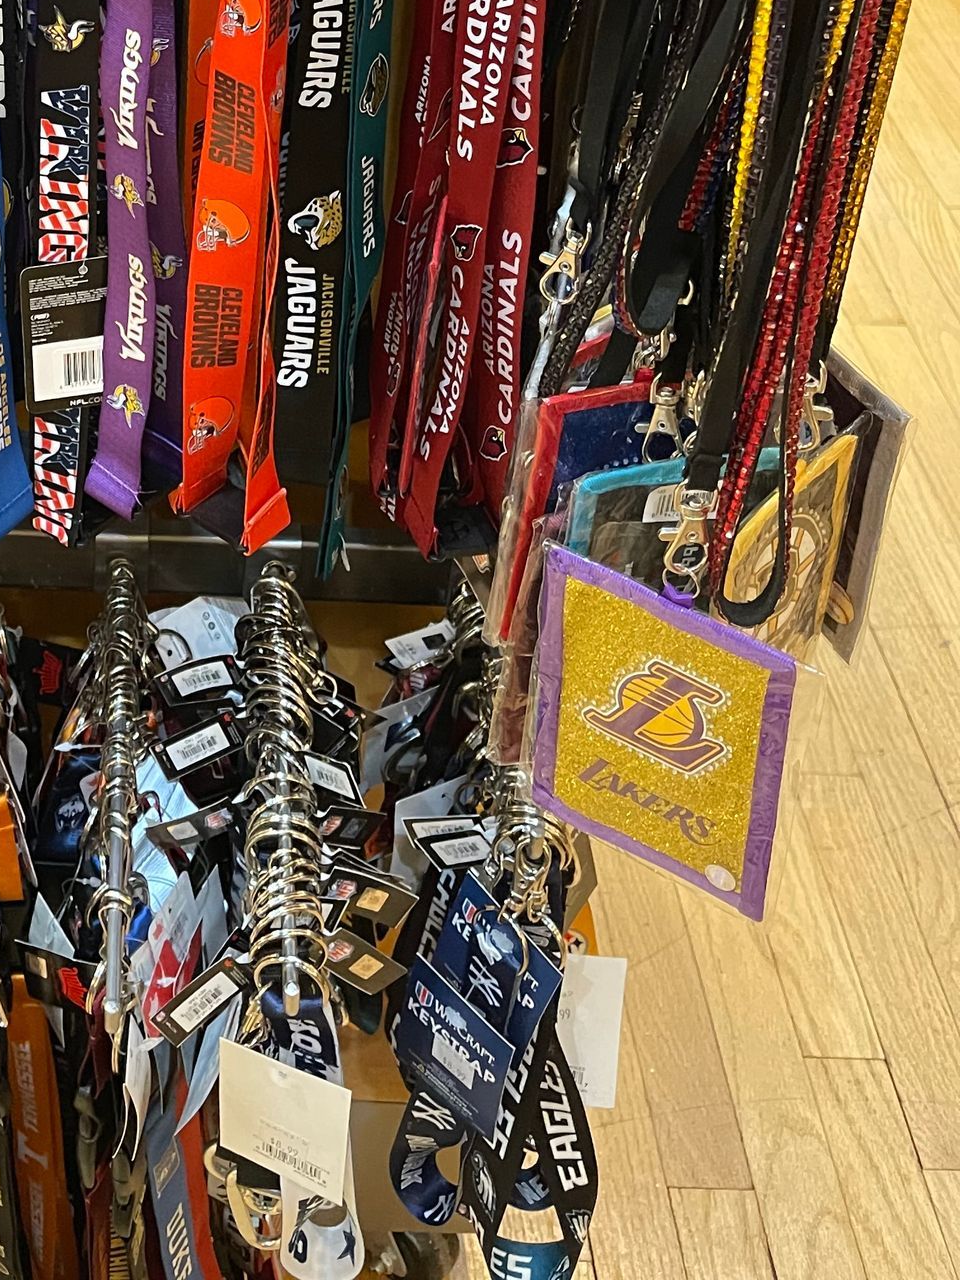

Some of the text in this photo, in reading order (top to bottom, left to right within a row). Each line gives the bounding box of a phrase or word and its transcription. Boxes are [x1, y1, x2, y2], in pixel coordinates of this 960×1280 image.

[207, 69, 237, 172] BROWNS
[234, 81, 255, 175] CLEVELAND
[414, 55, 432, 123] ARIZONA
[361, 154, 378, 259] JAGUARS
[190, 283, 222, 370] BROWNS
[217, 287, 244, 368] CLEVELAND
[276, 256, 317, 389] JAGUARS
[316, 273, 335, 375] JACKSONVILLE
[383, 291, 399, 353] ARIZONA
[420, 264, 465, 461] CARDINALS
[485, 264, 496, 376] ARIZONA
[498, 229, 523, 425] CARDINALS
[0, 373, 11, 448] ANGELES
[439, 316, 470, 434] ARIZONA
[577, 758, 722, 850] LAKERS
[407, 997, 497, 1084] KEYSTRAP
